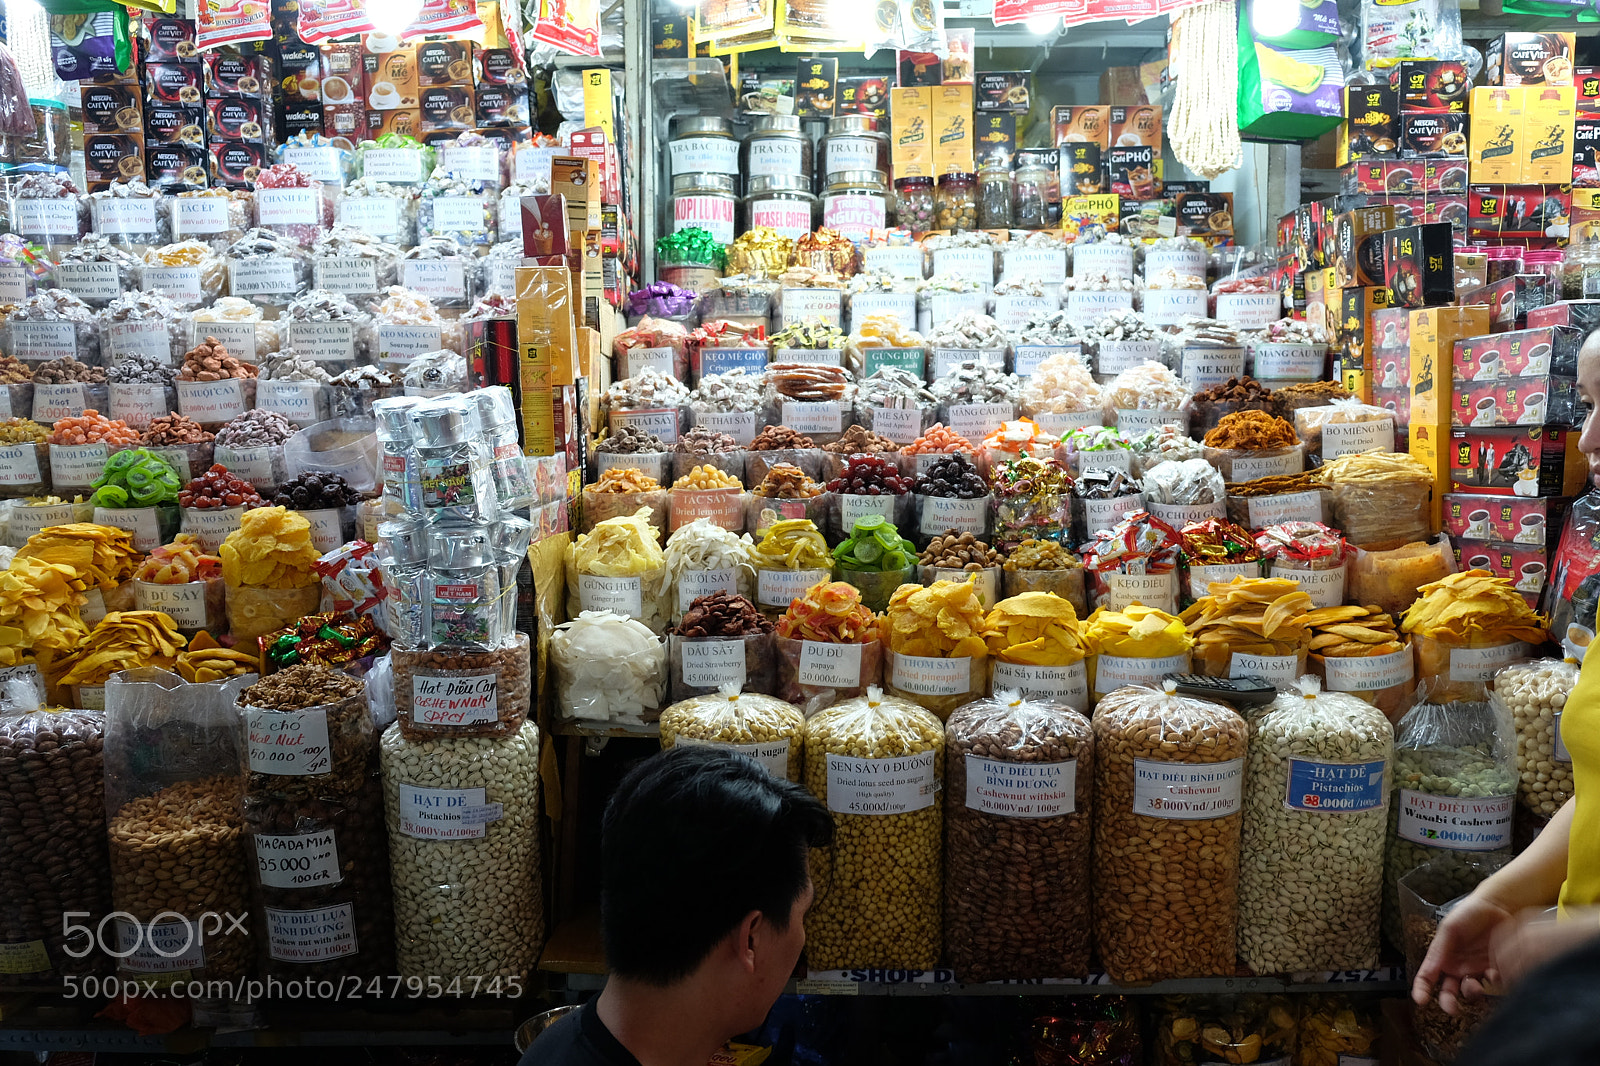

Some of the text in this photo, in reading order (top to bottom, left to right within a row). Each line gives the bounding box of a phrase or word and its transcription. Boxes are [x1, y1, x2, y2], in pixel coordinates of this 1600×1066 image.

[286, 112, 319, 122] wake-up
[675, 198, 696, 220] KOPI
[754, 212, 810, 229] WEASEL COFFEE
[1326, 427, 1340, 435] BÒ
[1084, 454, 1103, 464] KẸO
[675, 507, 722, 516] Dried lemon
[1090, 505, 1110, 513] KẸO
[933, 514, 976, 524] Dried plums
[201, 526, 226, 534] Apricot
[763, 584, 782, 592] Dried
[1118, 578, 1165, 590] KẸO ĐIỀU
[808, 646, 823, 656] ĐU
[705, 661, 742, 669] Strawberry
[811, 662, 834, 670] papaya
[1239, 659, 1292, 670] XOÀI SẤY
[897, 669, 918, 680] Dried
[1015, 666, 1065, 680] Sấy không
[1103, 670, 1125, 680] Dried
[1334, 670, 1380, 679] Dried large
[276, 733, 305, 746] Nut
[762, 747, 787, 759] sugar
[831, 761, 852, 772] SEN
[984, 764, 1060, 777] HẠT ĐIỀU LỤA
[1140, 770, 1214, 782] HẠT ĐIỀU BÌNH
[1315, 768, 1346, 780] HẠT
[837, 777, 856, 786] Dried
[878, 778, 894, 786] seed
[907, 776, 923, 784] sugar
[987, 775, 1057, 788] BÌNH DƯƠNG
[1170, 786, 1220, 794] Cashewnut
[1312, 782, 1363, 792] Pistachios
[977, 786, 1066, 800] Cashewnut withskin
[414, 794, 442, 808] HẠT
[1211, 799, 1234, 810] 100gr
[1410, 797, 1509, 813] HẠT ĐIỀU WASABI
[1037, 804, 1060, 813] 100gr
[419, 811, 460, 820] Pistachios
[1405, 807, 1493, 826] Wasabi Cashew
[1476, 833, 1503, 841] /100gr
[257, 836, 333, 850] MACADAMIA
[259, 856, 310, 871] 35.000
[291, 869, 330, 883] 100GR
[301, 922, 344, 936] DƯƠNG
[314, 936, 331, 945] with
[334, 932, 350, 941] skin
[325, 943, 351, 954] 100gr
[172, 958, 200, 968] 100gr
